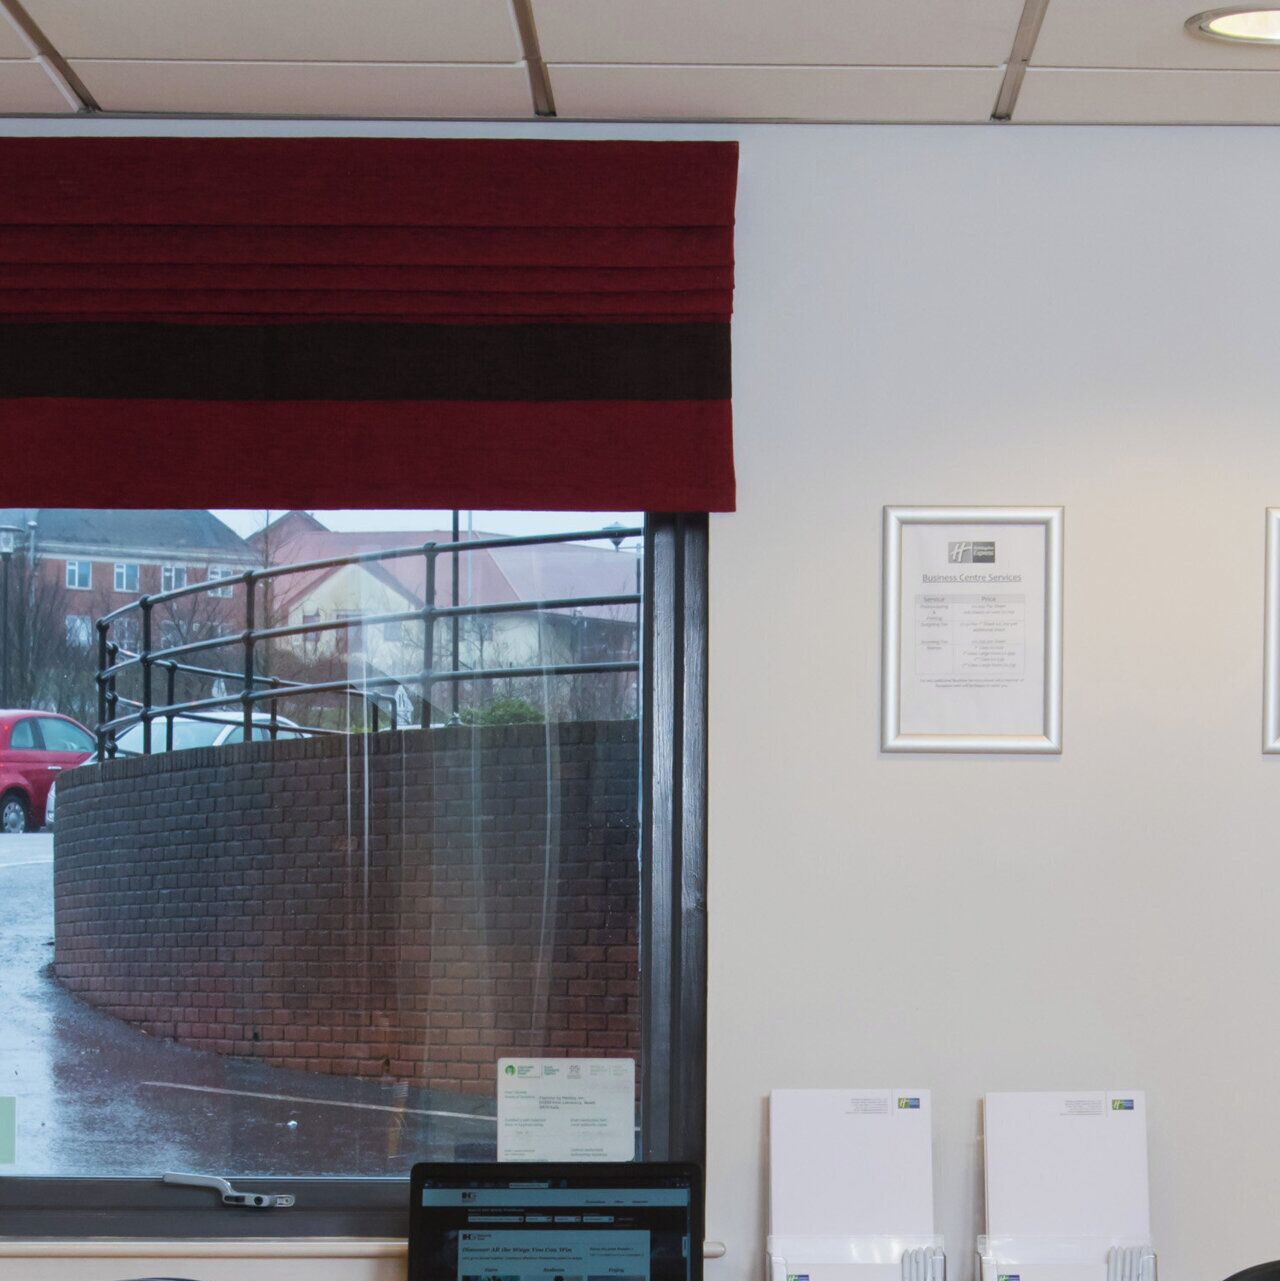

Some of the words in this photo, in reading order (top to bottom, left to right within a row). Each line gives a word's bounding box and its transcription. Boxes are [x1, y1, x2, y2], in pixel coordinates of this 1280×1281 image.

[922, 573, 957, 583] Business
[959, 573, 986, 583] Centre
[988, 573, 1022, 582] Services
